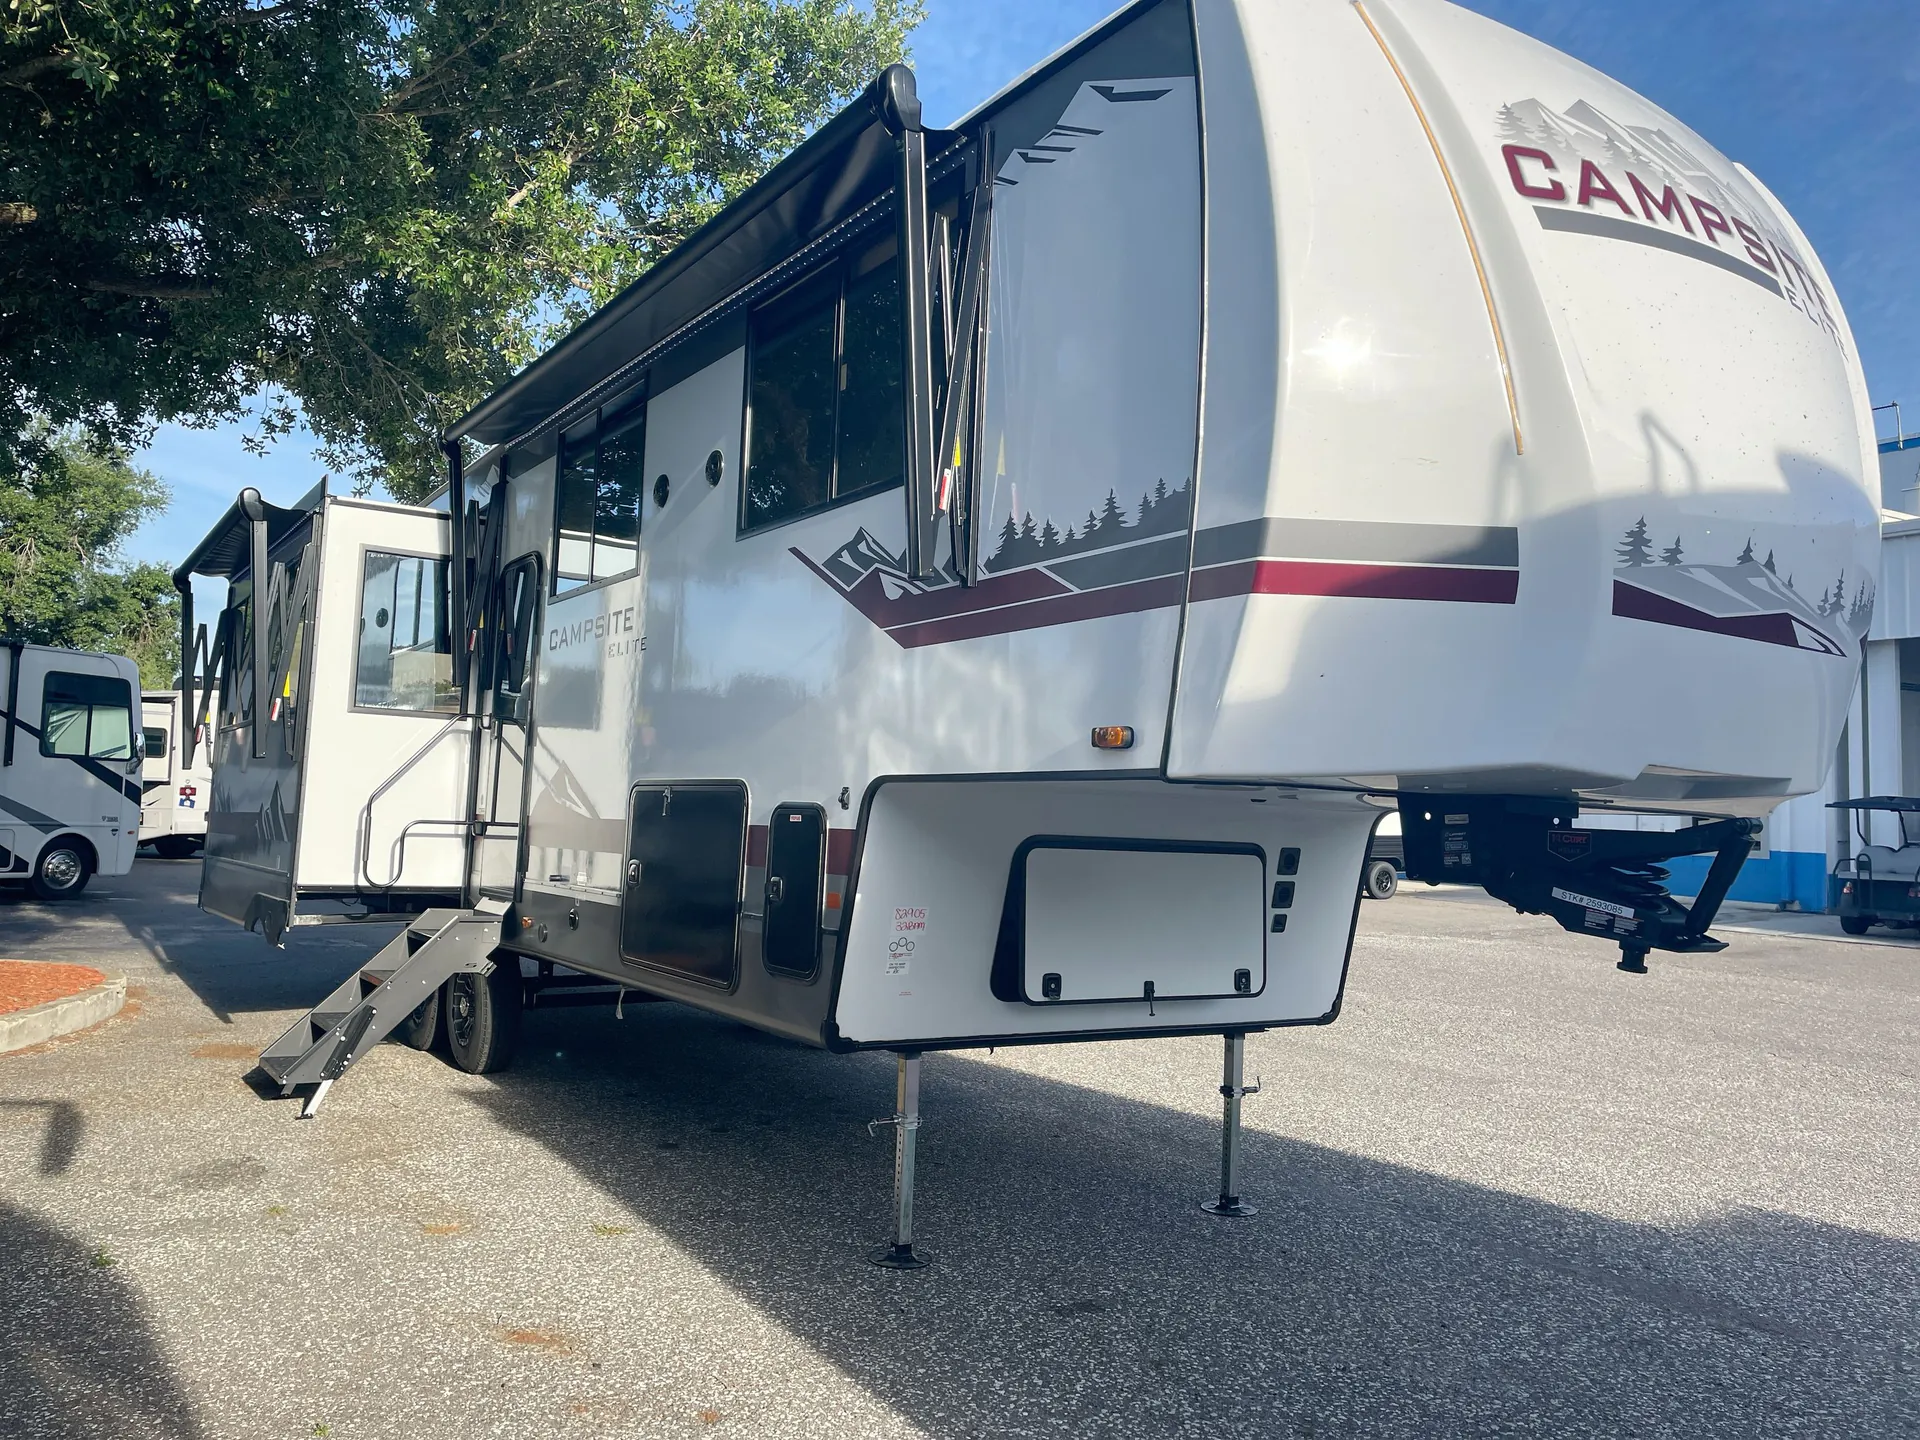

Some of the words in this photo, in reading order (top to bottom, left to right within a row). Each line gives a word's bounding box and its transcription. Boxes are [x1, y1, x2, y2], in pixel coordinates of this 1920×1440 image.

[1501, 144, 1841, 337] CAMPSITE
[1783, 284, 1850, 364] ELITE
[549, 606, 634, 651] CAMPSITE
[607, 636, 648, 659] ELITE
[895, 907, 928, 920] 82905
[1561, 891, 1584, 903] STK#
[1586, 898, 1623, 915] 2593085
